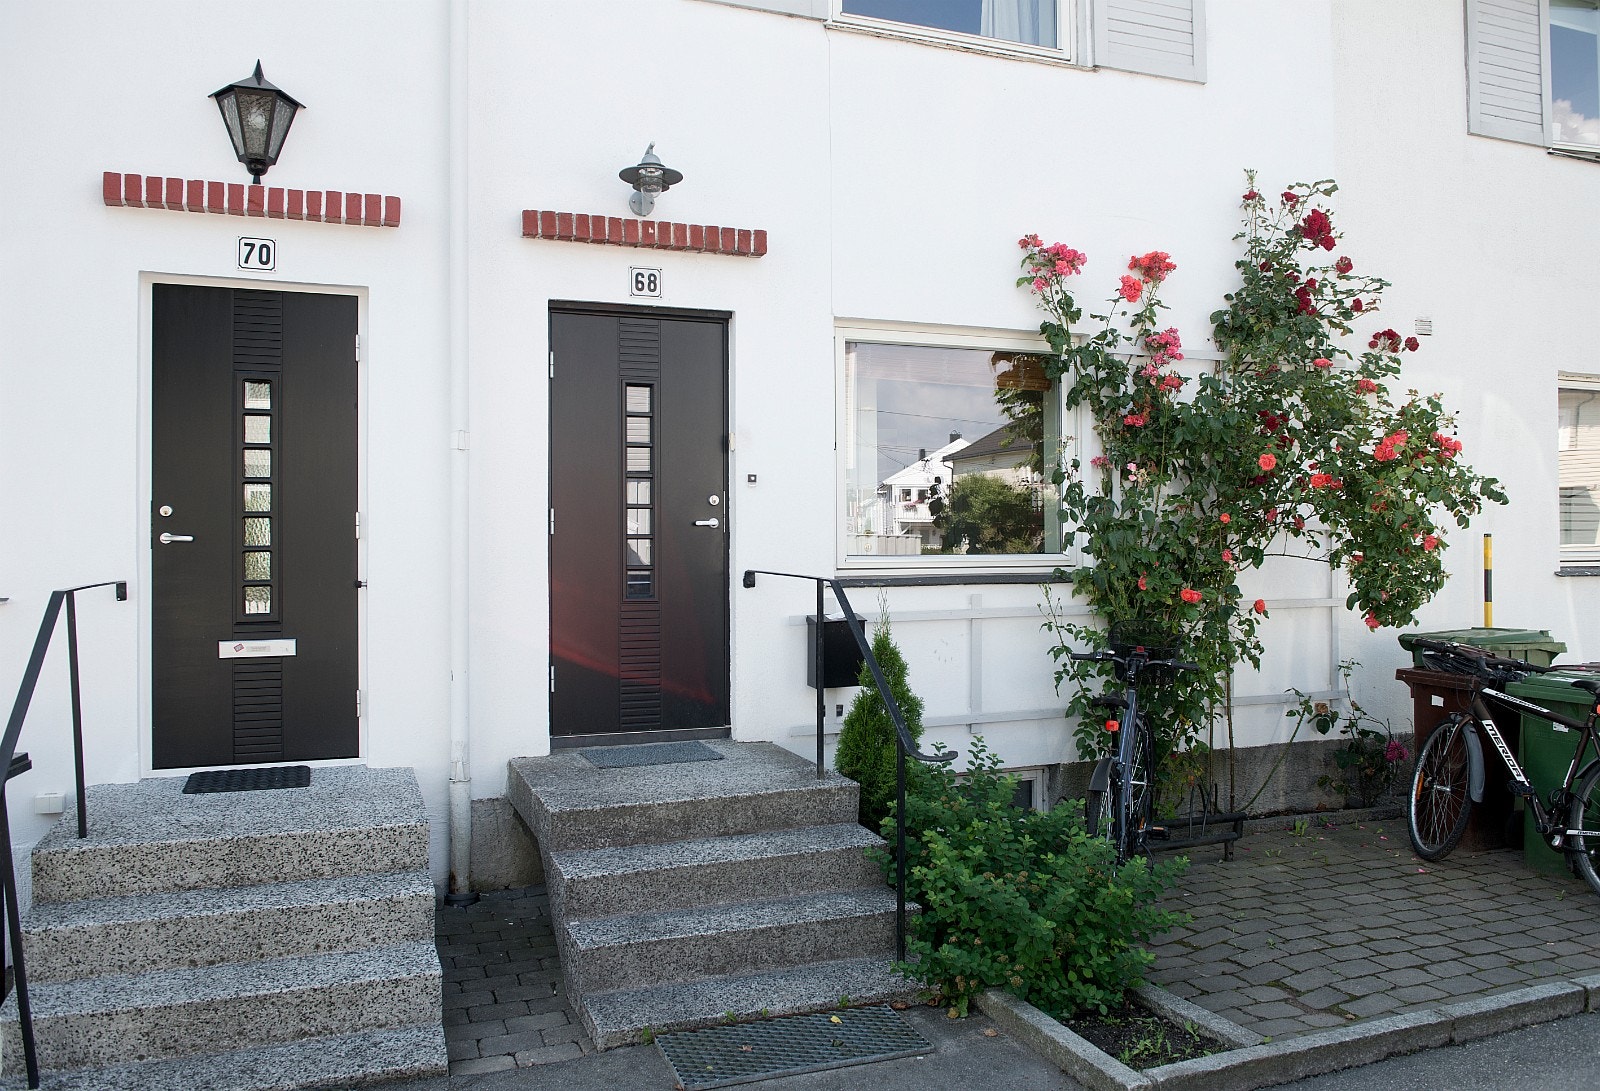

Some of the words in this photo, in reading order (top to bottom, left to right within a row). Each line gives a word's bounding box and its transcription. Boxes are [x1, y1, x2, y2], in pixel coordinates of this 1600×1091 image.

[243, 242, 271, 265] 70
[634, 272, 658, 292] 68
[1484, 723, 1522, 777] MERIDA
